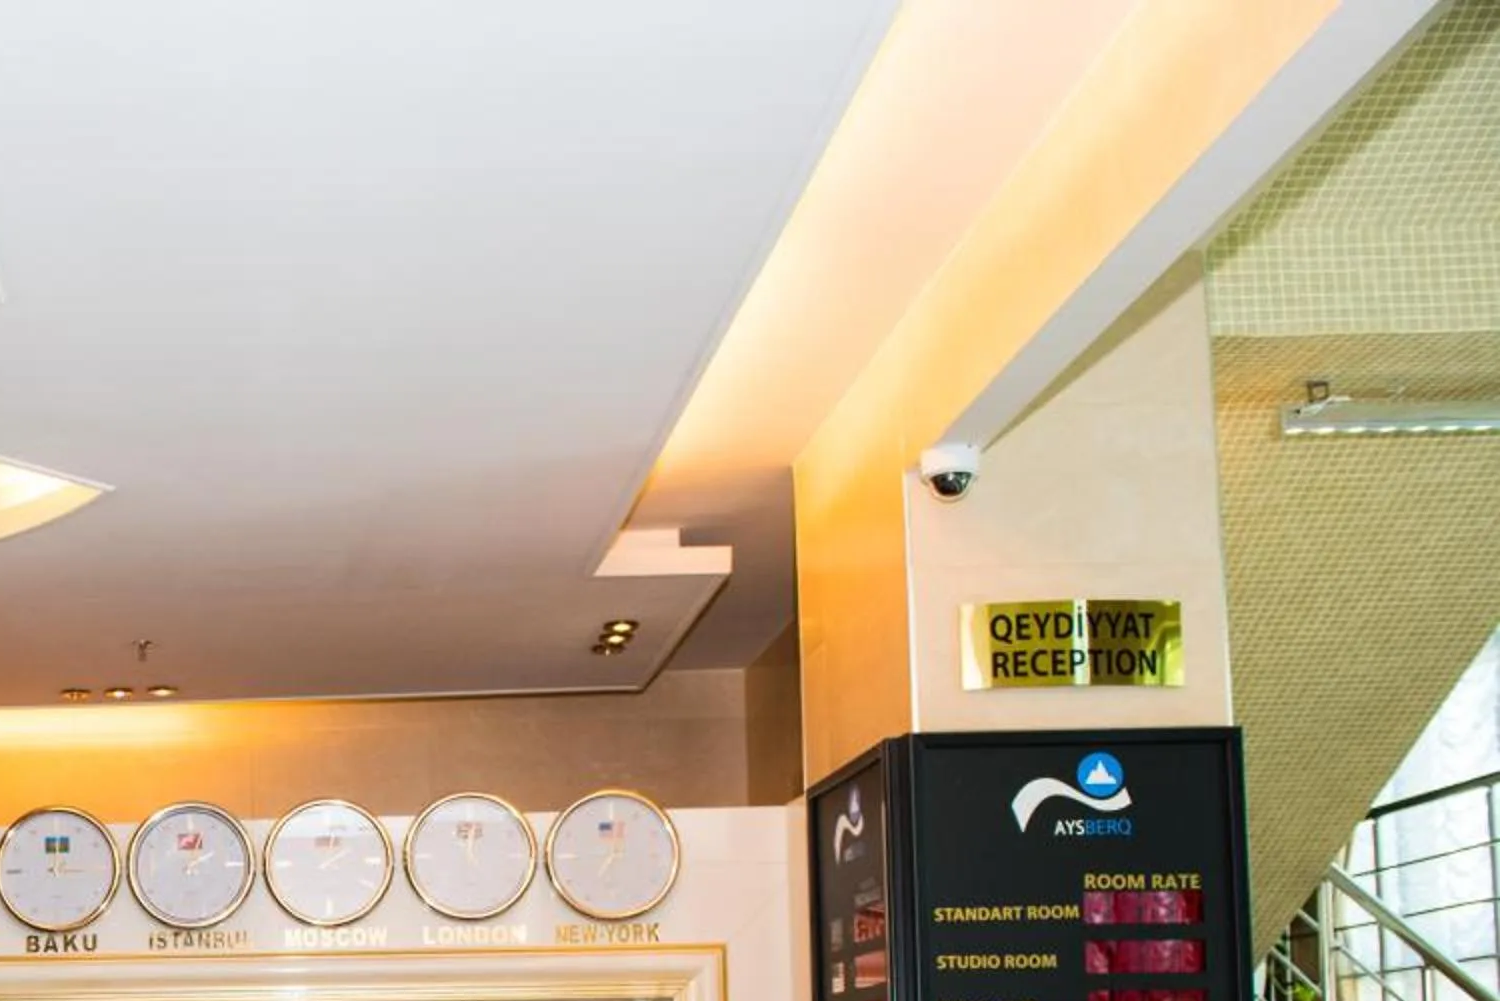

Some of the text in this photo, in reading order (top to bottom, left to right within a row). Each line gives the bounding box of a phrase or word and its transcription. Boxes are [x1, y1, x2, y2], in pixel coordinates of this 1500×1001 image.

[990, 606, 1154, 643] QEYDİYYAT
[992, 649, 1157, 677] RECEPTION
[1054, 819, 1132, 835] AYSBERQ
[1084, 873, 1201, 889] ROOM RATE
[934, 903, 1080, 922] STANDART ROOM
[26, 934, 97, 953] BAKU
[284, 926, 388, 948] MOSCOW
[422, 924, 527, 945] LONDON
[936, 954, 1057, 970] STUDIO ROOM
